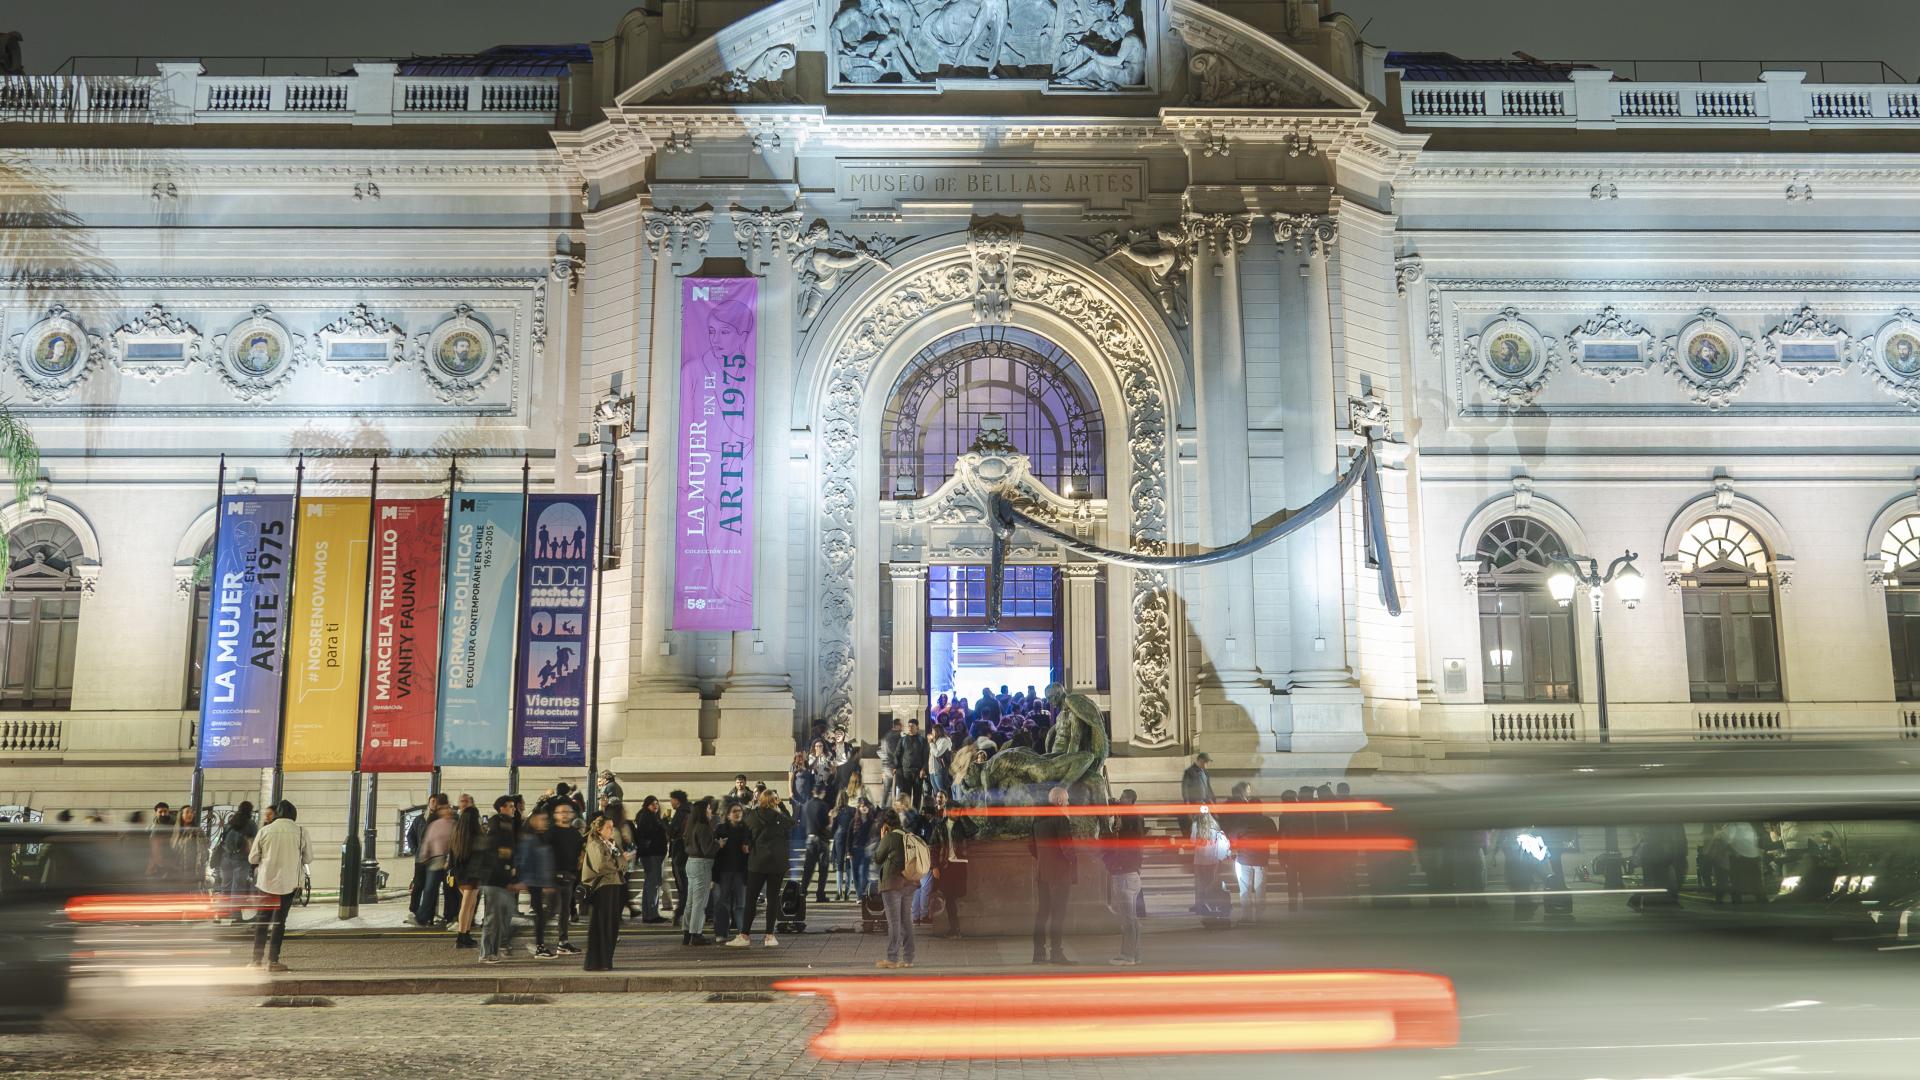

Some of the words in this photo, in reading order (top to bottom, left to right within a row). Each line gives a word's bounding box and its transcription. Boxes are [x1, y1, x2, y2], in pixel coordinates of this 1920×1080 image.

[849, 174, 926, 193] MUSEO
[966, 173, 1052, 193] BELLAS
[1064, 173, 1134, 193] ARTES
[704, 372, 717, 389] EL
[722, 354, 746, 421] 1975
[703, 395, 716, 417] EN
[688, 420, 711, 501] MUJER
[719, 441, 744, 537] ARTE
[476, 524, 485, 549] CHILE
[687, 506, 705, 537] LA
[246, 547, 257, 562] EL
[257, 520, 284, 585] 1975
[475, 551, 483, 563] EN
[484, 525, 494, 568] 1965-2005
[244, 565, 256, 583] EN
[380, 529, 398, 611] TRUJILLO
[453, 524, 474, 611] POLÍTICAS
[531, 565, 587, 586] NDM
[400, 569, 417, 629] FAUNA
[531, 586, 569, 597] noche
[570, 586, 586, 597] de
[216, 571, 244, 662] MUJER
[307, 541, 329, 683] #NOSRENOVAMOS
[326, 623, 339, 633] ti
[251, 594, 279, 672] ARTE
[326, 635, 340, 668] para
[448, 615, 467, 689] FORMAS
[376, 614, 394, 700] MARCELA
[397, 634, 413, 699] VANITY
[466, 638, 477, 688] ESCULTURA
[213, 669, 237, 703] LA
[525, 694, 580, 707] Viernes
[526, 708, 533, 716] 11
[533, 707, 545, 716] de
[546, 707, 579, 716] octubre
